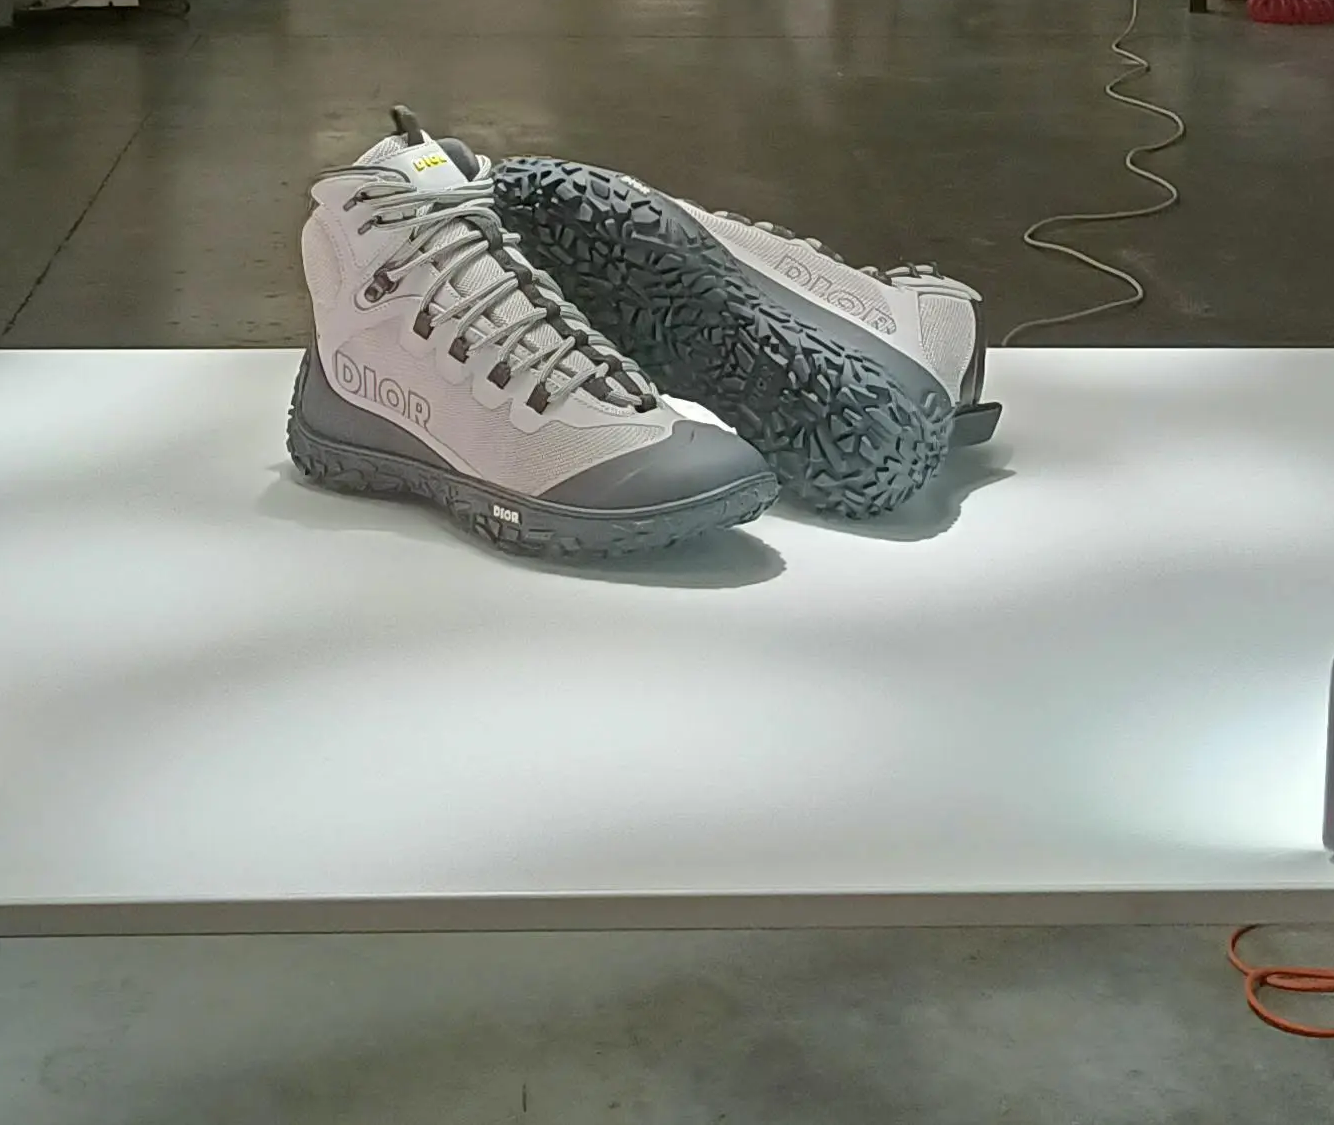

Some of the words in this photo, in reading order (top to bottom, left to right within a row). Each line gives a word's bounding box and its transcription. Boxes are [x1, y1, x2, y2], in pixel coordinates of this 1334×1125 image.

[774, 255, 897, 336] DIOR
[335, 349, 431, 432] DIOR
[493, 504, 519, 524] DIOR
